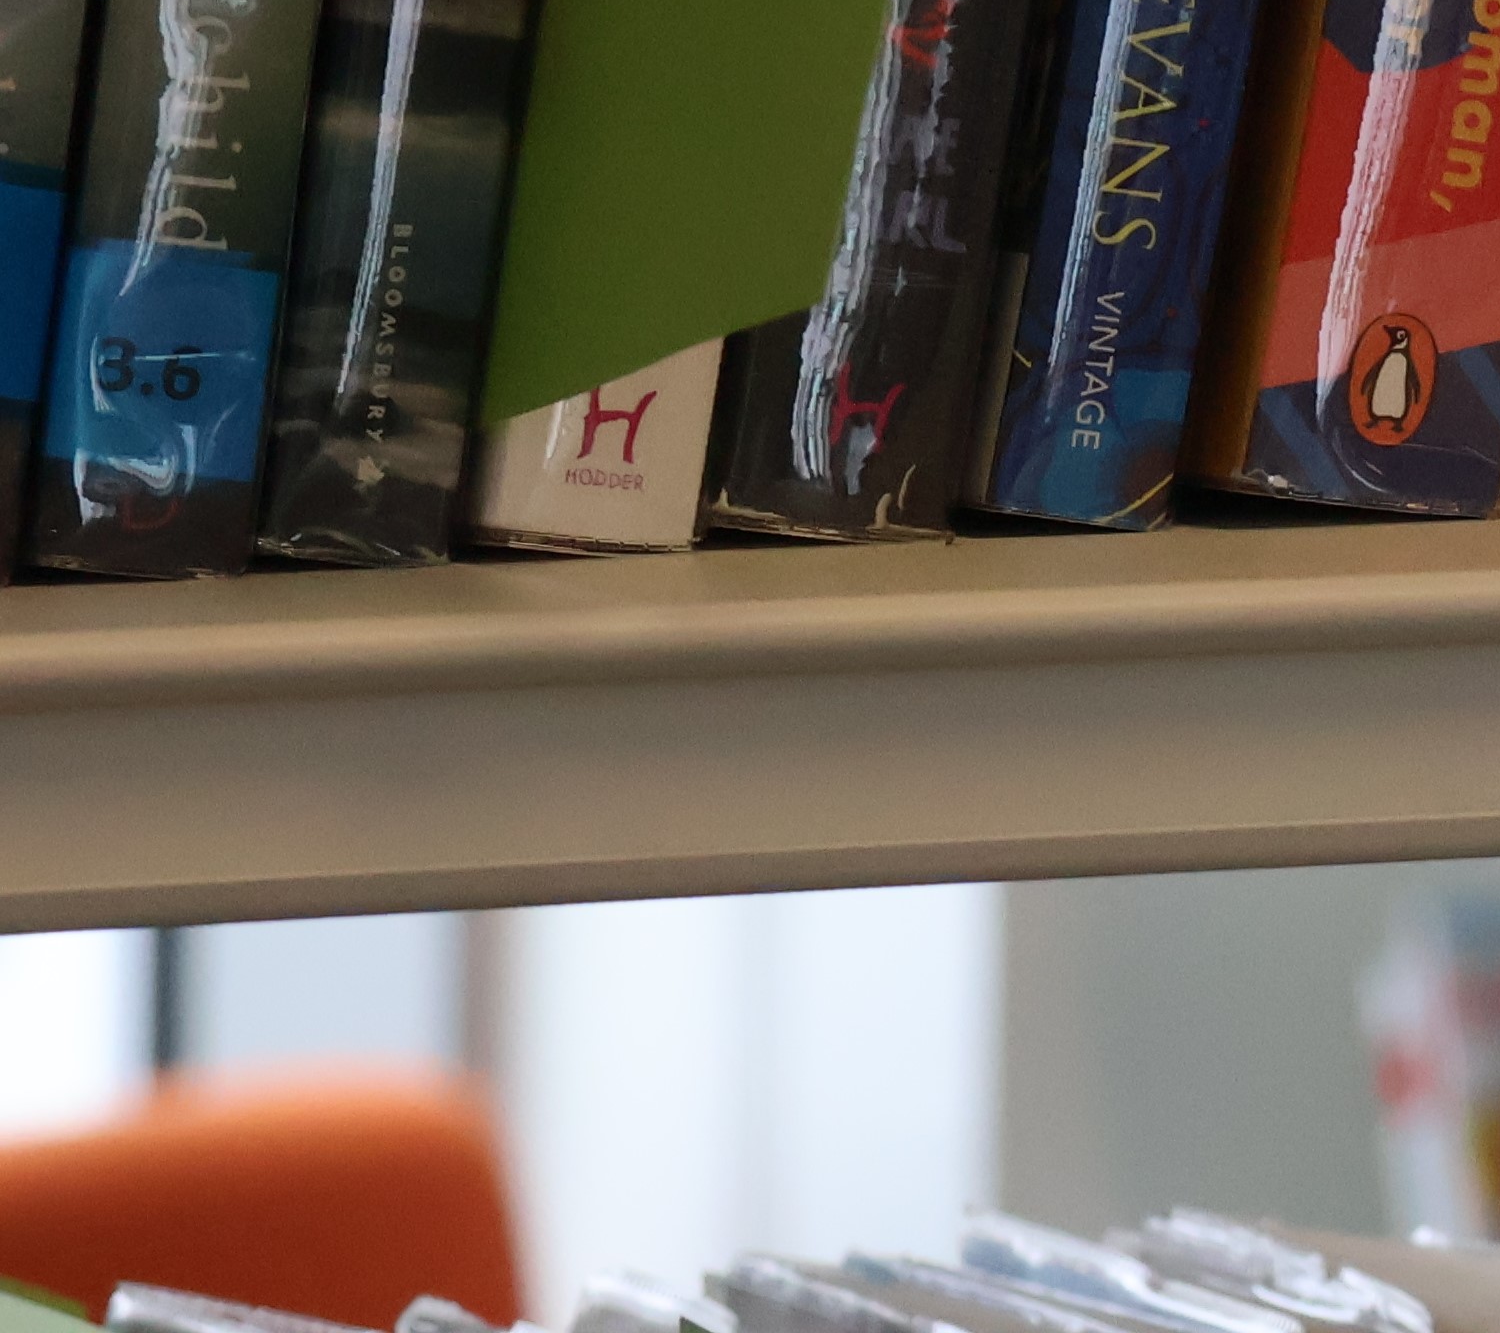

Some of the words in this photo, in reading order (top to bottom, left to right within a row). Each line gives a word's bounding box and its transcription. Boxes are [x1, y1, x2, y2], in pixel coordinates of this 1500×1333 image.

[100, 337, 201, 401] 3.6
[365, 223, 414, 443] BLOOMSBURY
[1070, 292, 1126, 453] VINTAGE
[566, 468, 644, 491] HODDER
